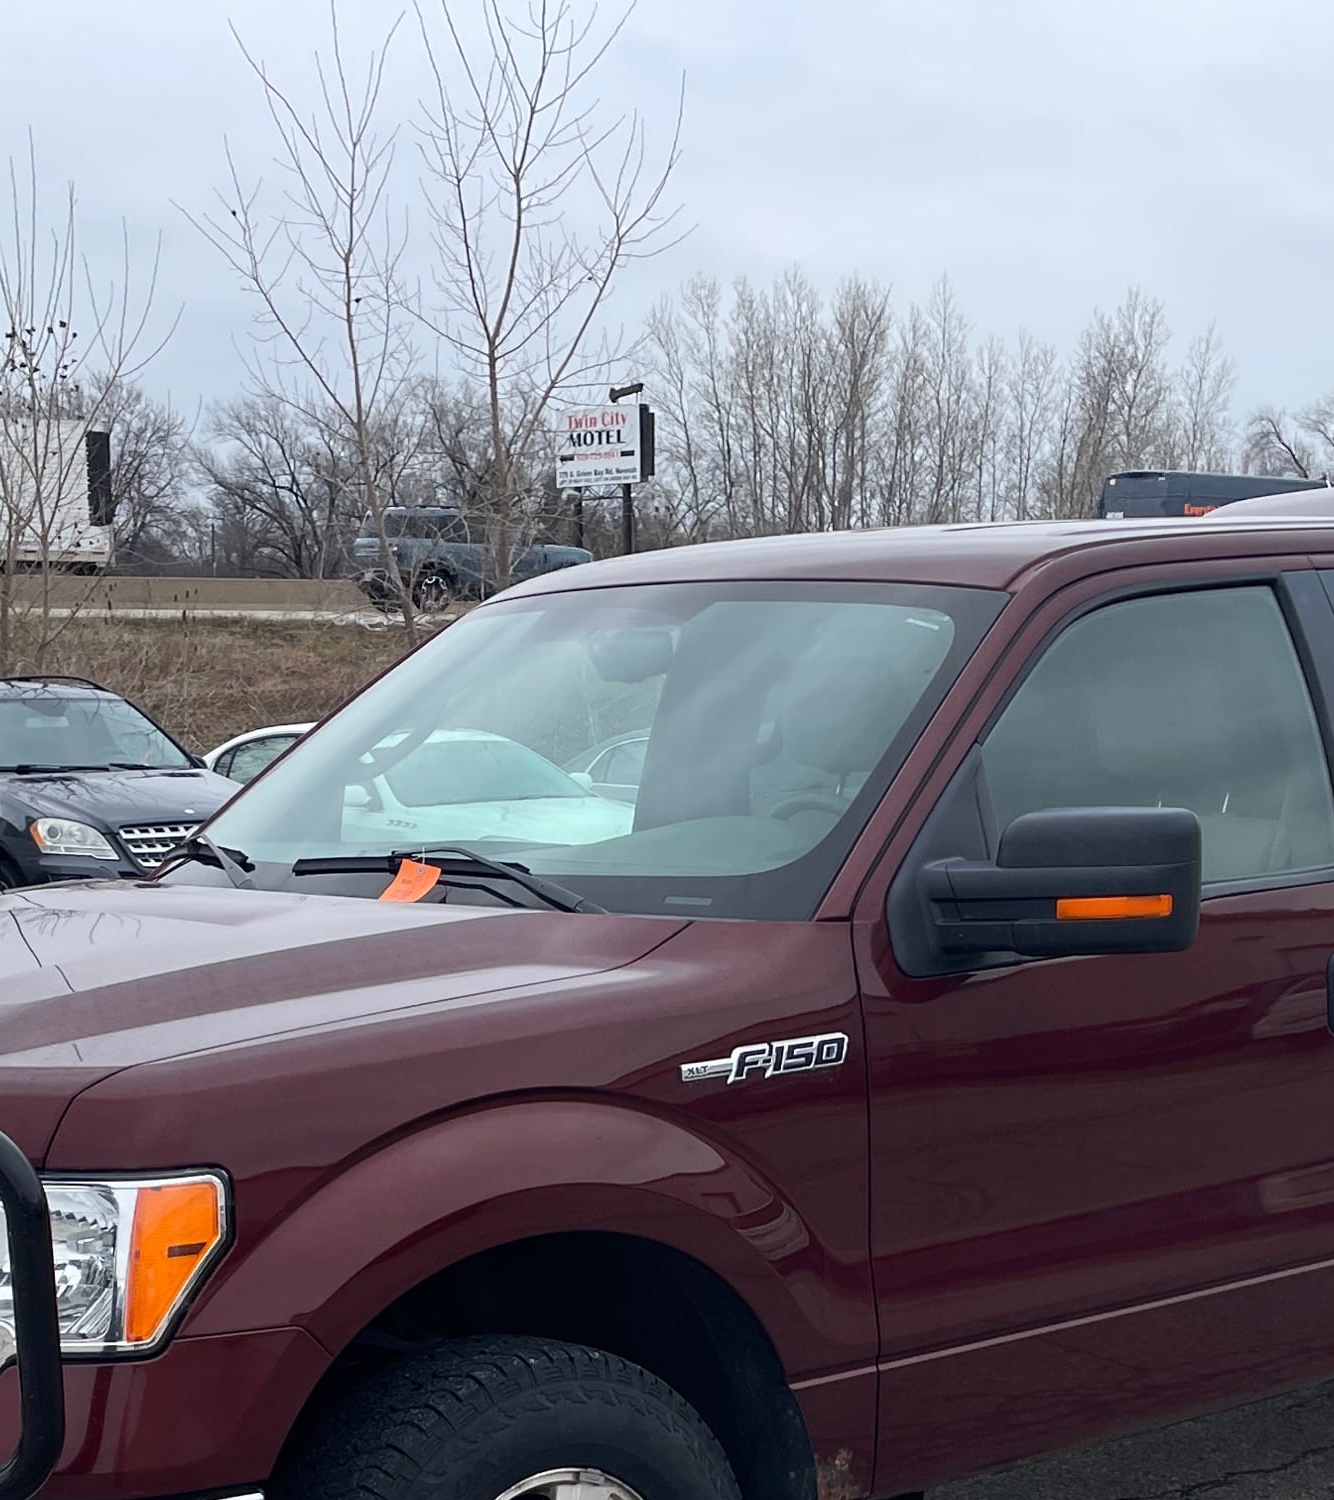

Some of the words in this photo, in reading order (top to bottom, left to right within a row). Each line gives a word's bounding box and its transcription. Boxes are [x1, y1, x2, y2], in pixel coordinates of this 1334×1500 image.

[567, 415, 597, 429] Twin
[601, 411, 627, 427] City
[569, 429, 626, 447] MOTEL
[686, 1064, 710, 1076] XLT
